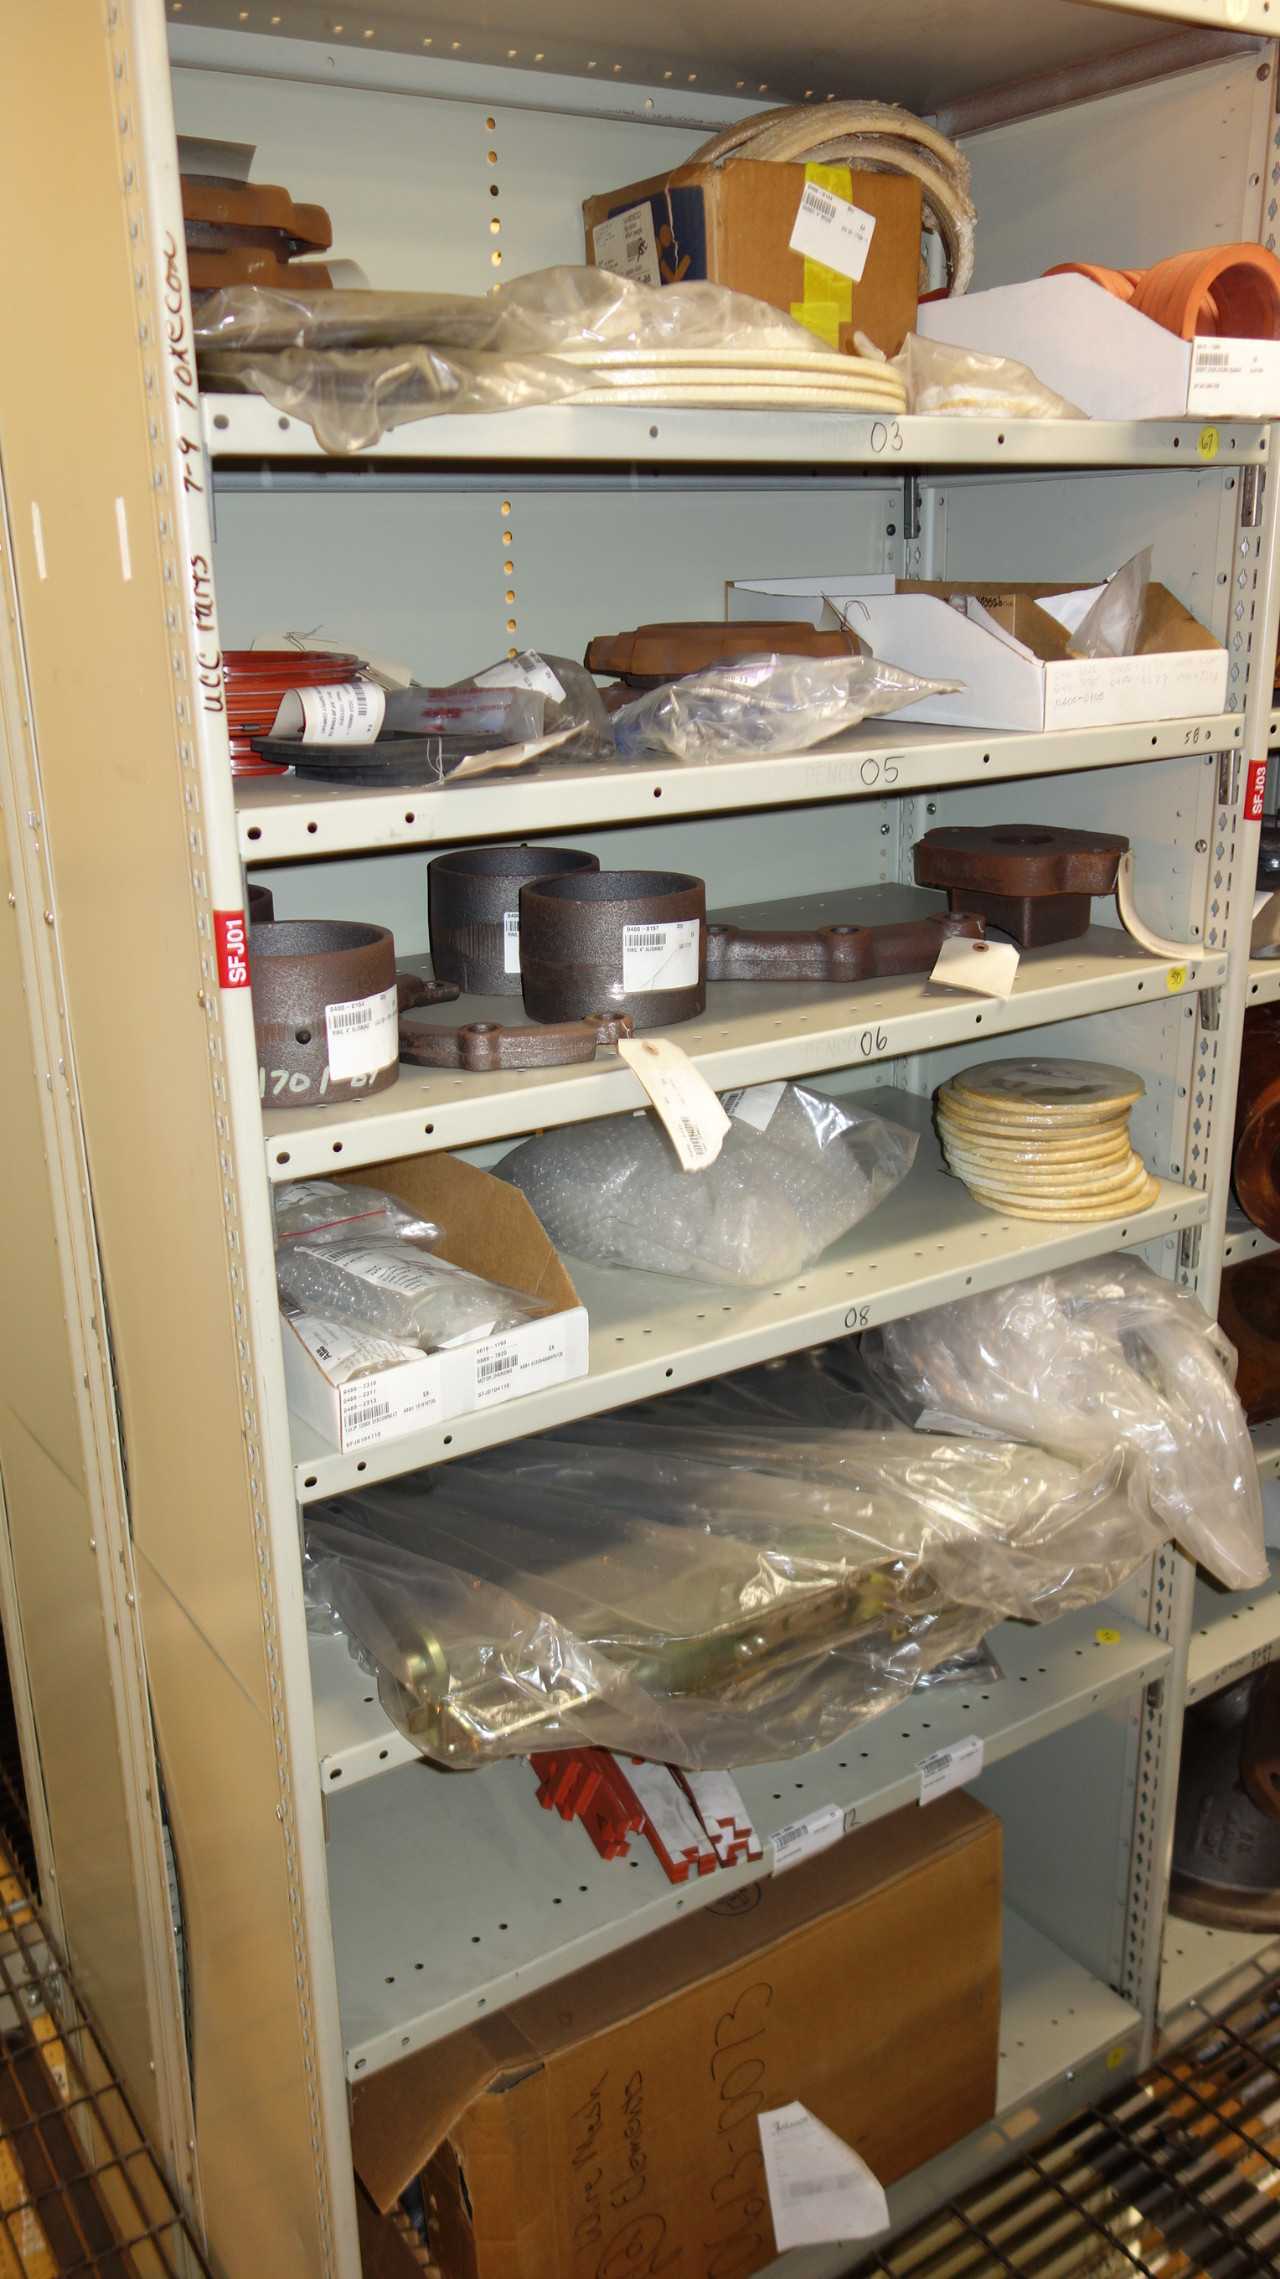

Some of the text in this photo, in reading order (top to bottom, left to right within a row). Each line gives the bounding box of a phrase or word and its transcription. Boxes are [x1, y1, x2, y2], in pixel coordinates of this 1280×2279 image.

[870, 420, 904, 453] 03
[859, 755, 906, 787] 05
[1251, 765, 1268, 816] SFJ03
[226, 919, 248, 983] SFJ01
[860, 1024, 889, 1057] 06
[844, 1303, 872, 1329] 08
